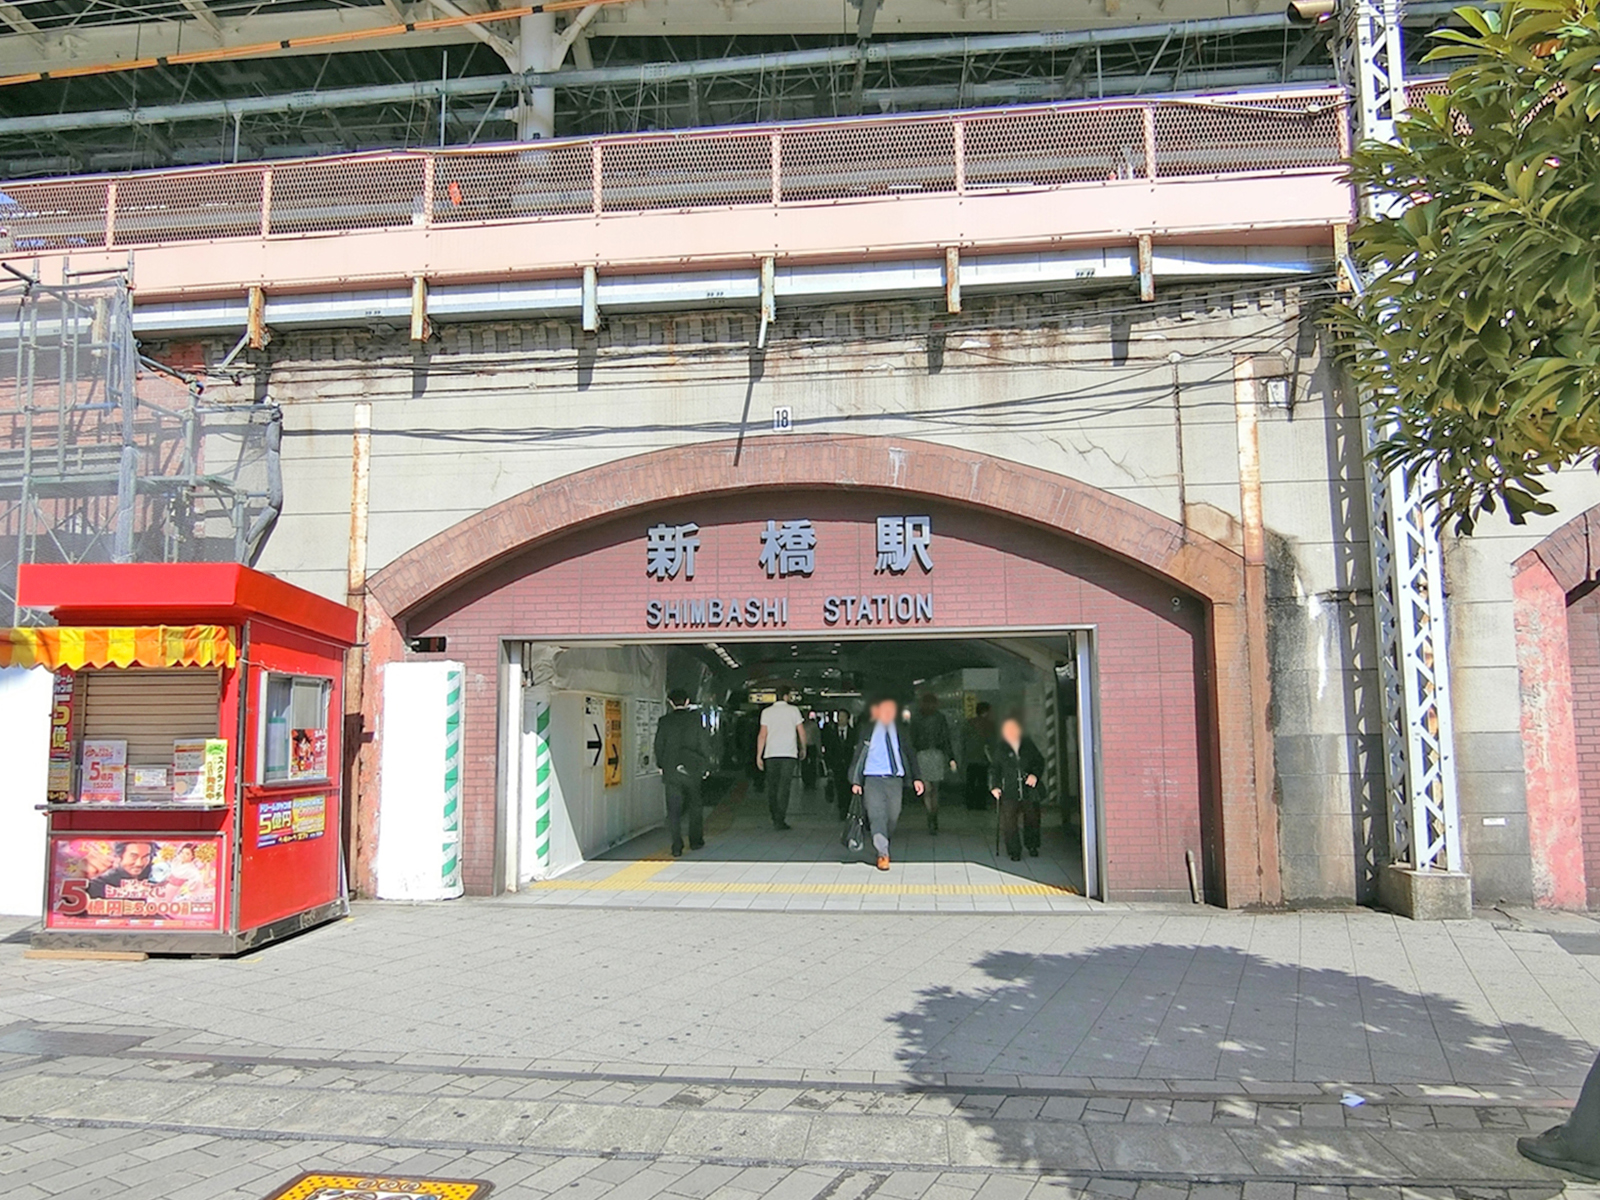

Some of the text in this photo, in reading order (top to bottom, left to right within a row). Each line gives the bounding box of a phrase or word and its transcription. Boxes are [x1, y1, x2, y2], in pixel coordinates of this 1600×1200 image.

[776, 409, 789, 428] 18
[647, 516, 933, 580] 新橋駅
[646, 592, 933, 628] SHIMBASHI STATION
